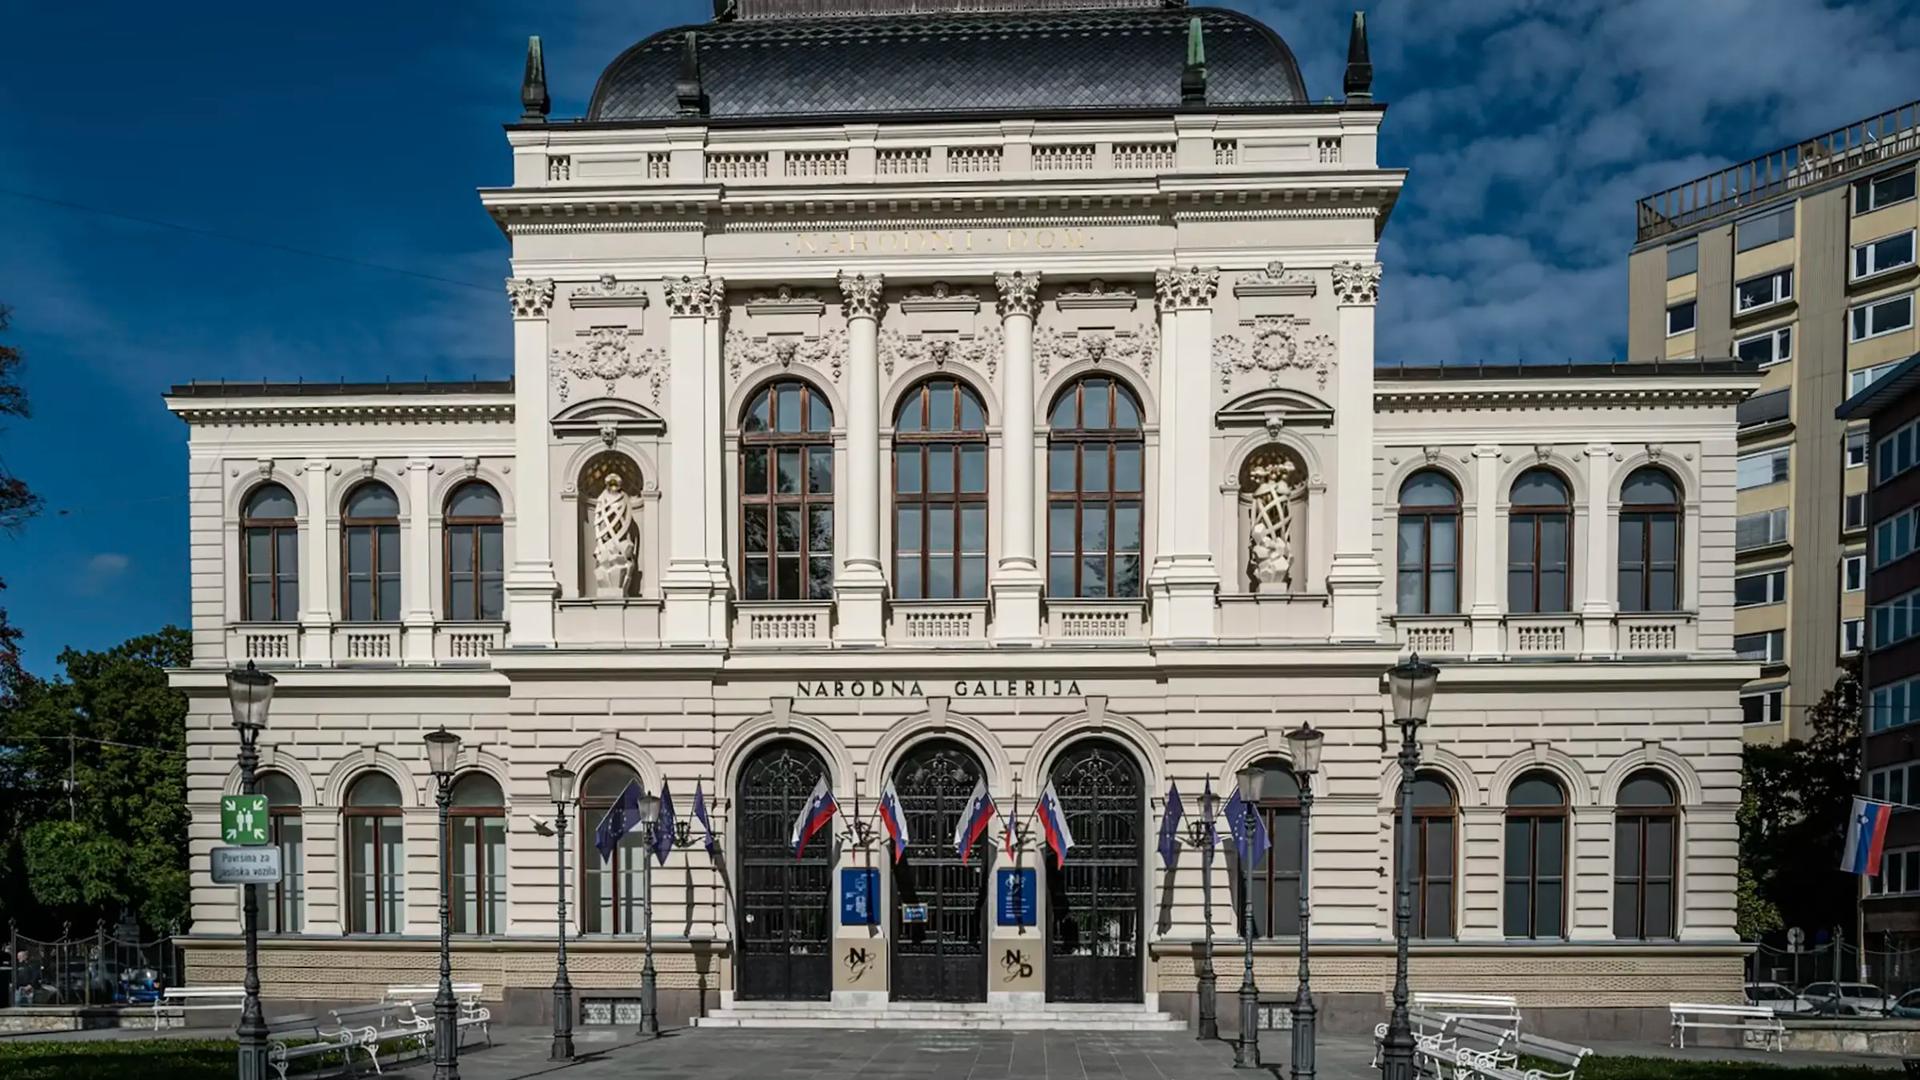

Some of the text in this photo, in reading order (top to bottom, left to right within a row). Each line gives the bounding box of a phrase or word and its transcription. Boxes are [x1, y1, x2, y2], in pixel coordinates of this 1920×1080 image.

[797, 680, 1082, 697] NARODNA GALERIJA
[260, 853, 270, 862] za
